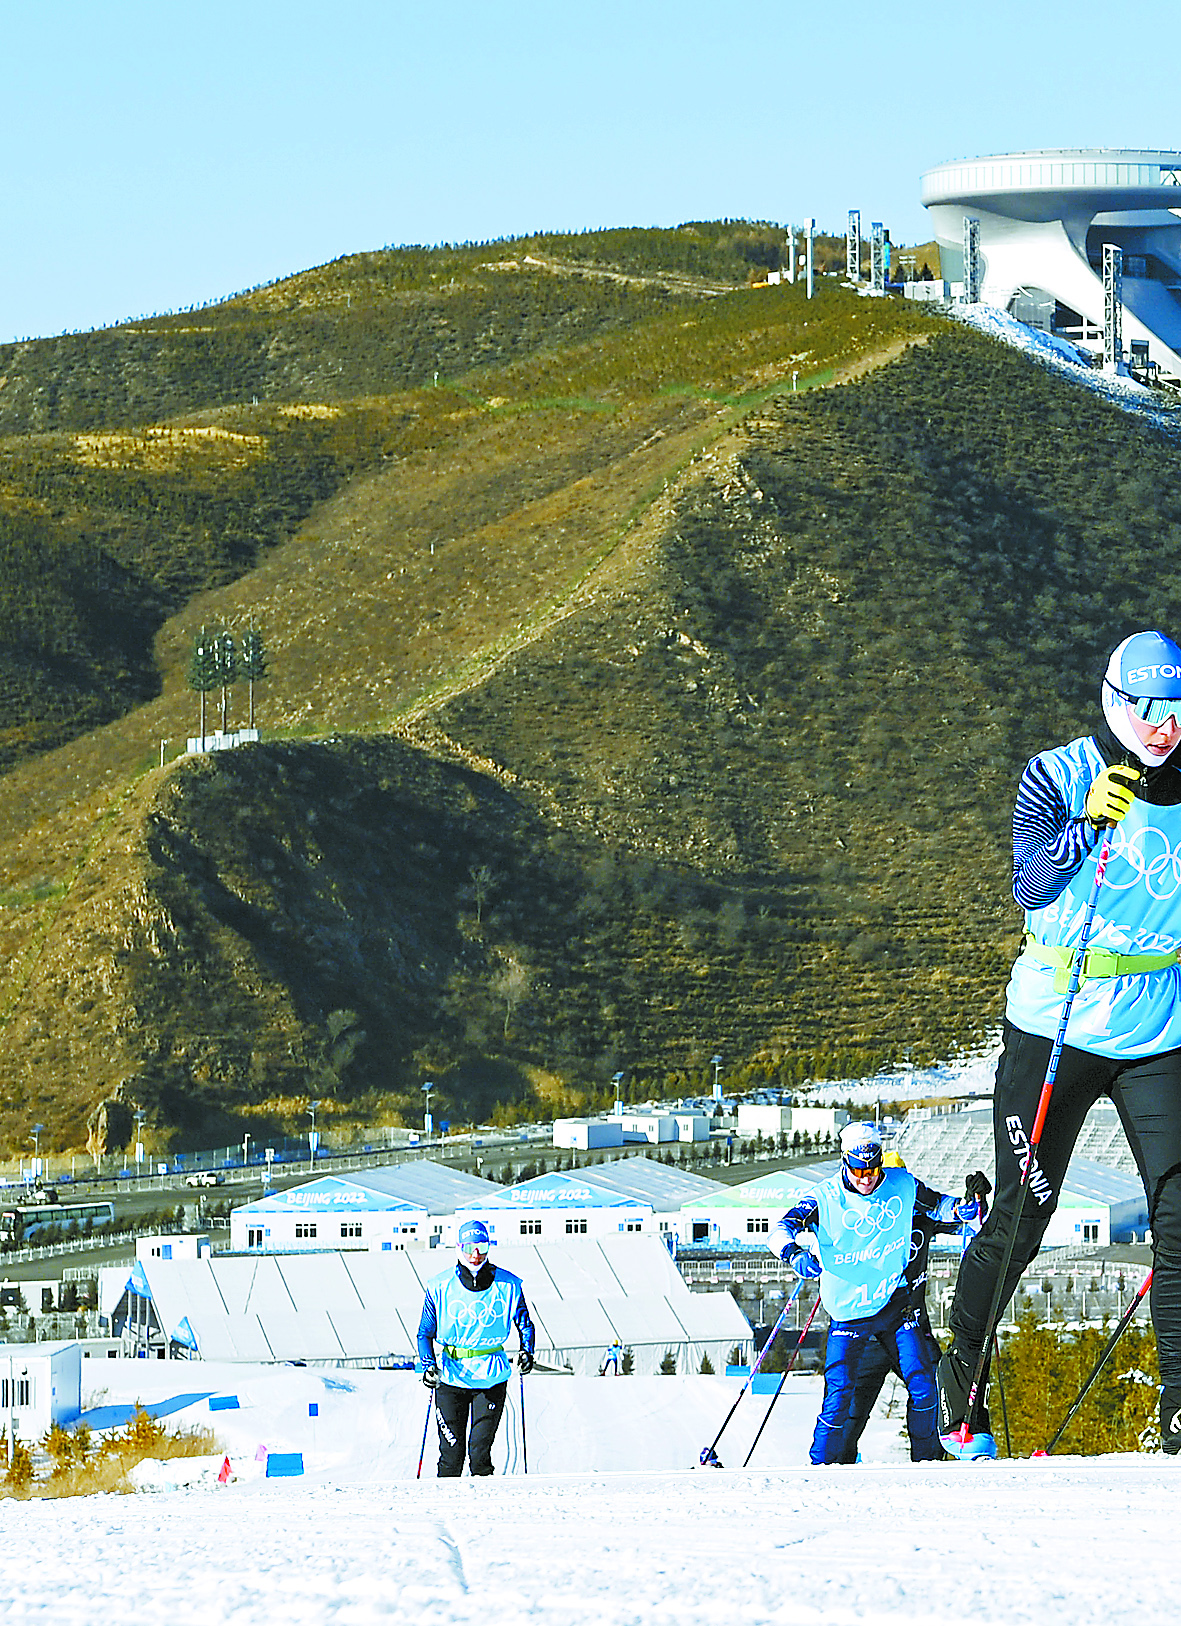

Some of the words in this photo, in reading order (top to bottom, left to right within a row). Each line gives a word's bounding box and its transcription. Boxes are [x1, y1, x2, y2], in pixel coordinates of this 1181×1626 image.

[1005, 1115, 1053, 1206] ESTONIA
[286, 1192, 331, 1206] BEIJING
[333, 1192, 368, 1204] 2022
[511, 1189, 556, 1203] BEIJING
[558, 1188, 593, 1200] 2022
[740, 1187, 785, 1202] BEIJING
[834, 1247, 881, 1265] BEIJING
